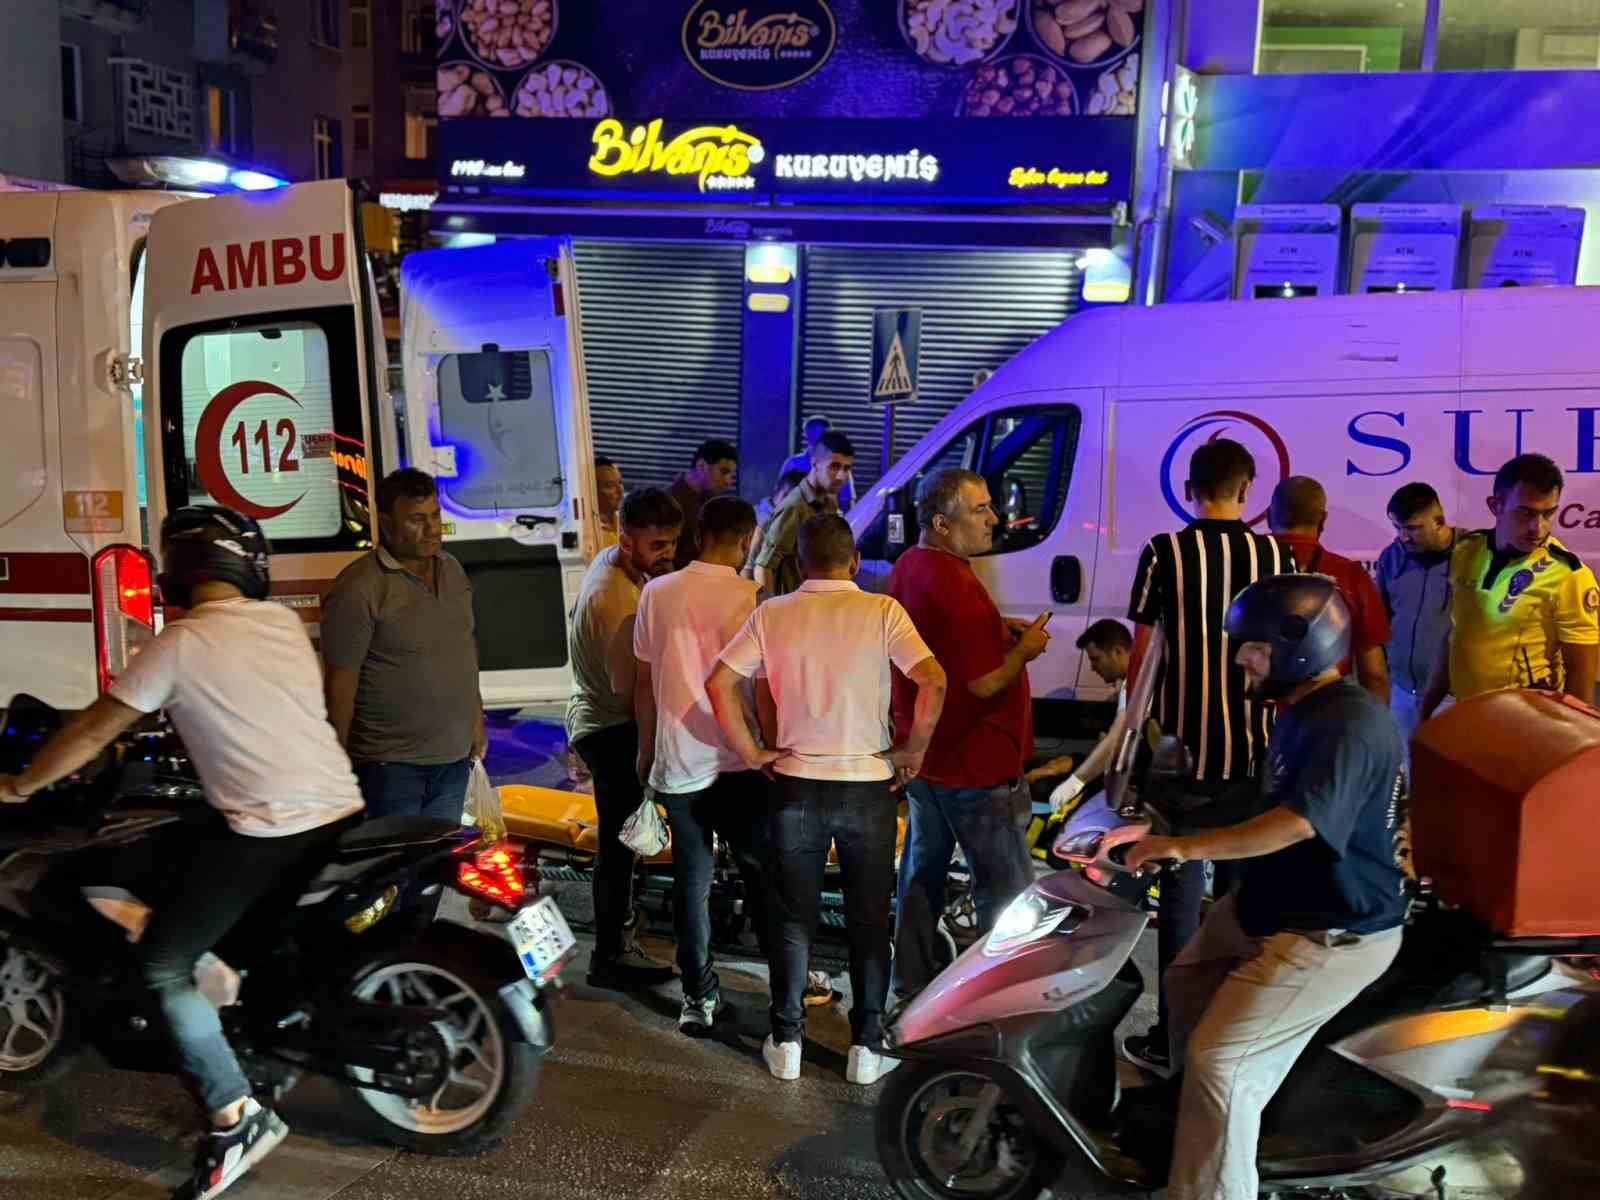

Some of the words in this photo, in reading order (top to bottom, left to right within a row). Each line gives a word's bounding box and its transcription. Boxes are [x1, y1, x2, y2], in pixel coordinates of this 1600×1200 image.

[191, 232, 345, 295] AMBU
[232, 418, 299, 474] 112
[76, 494, 110, 516] 112
